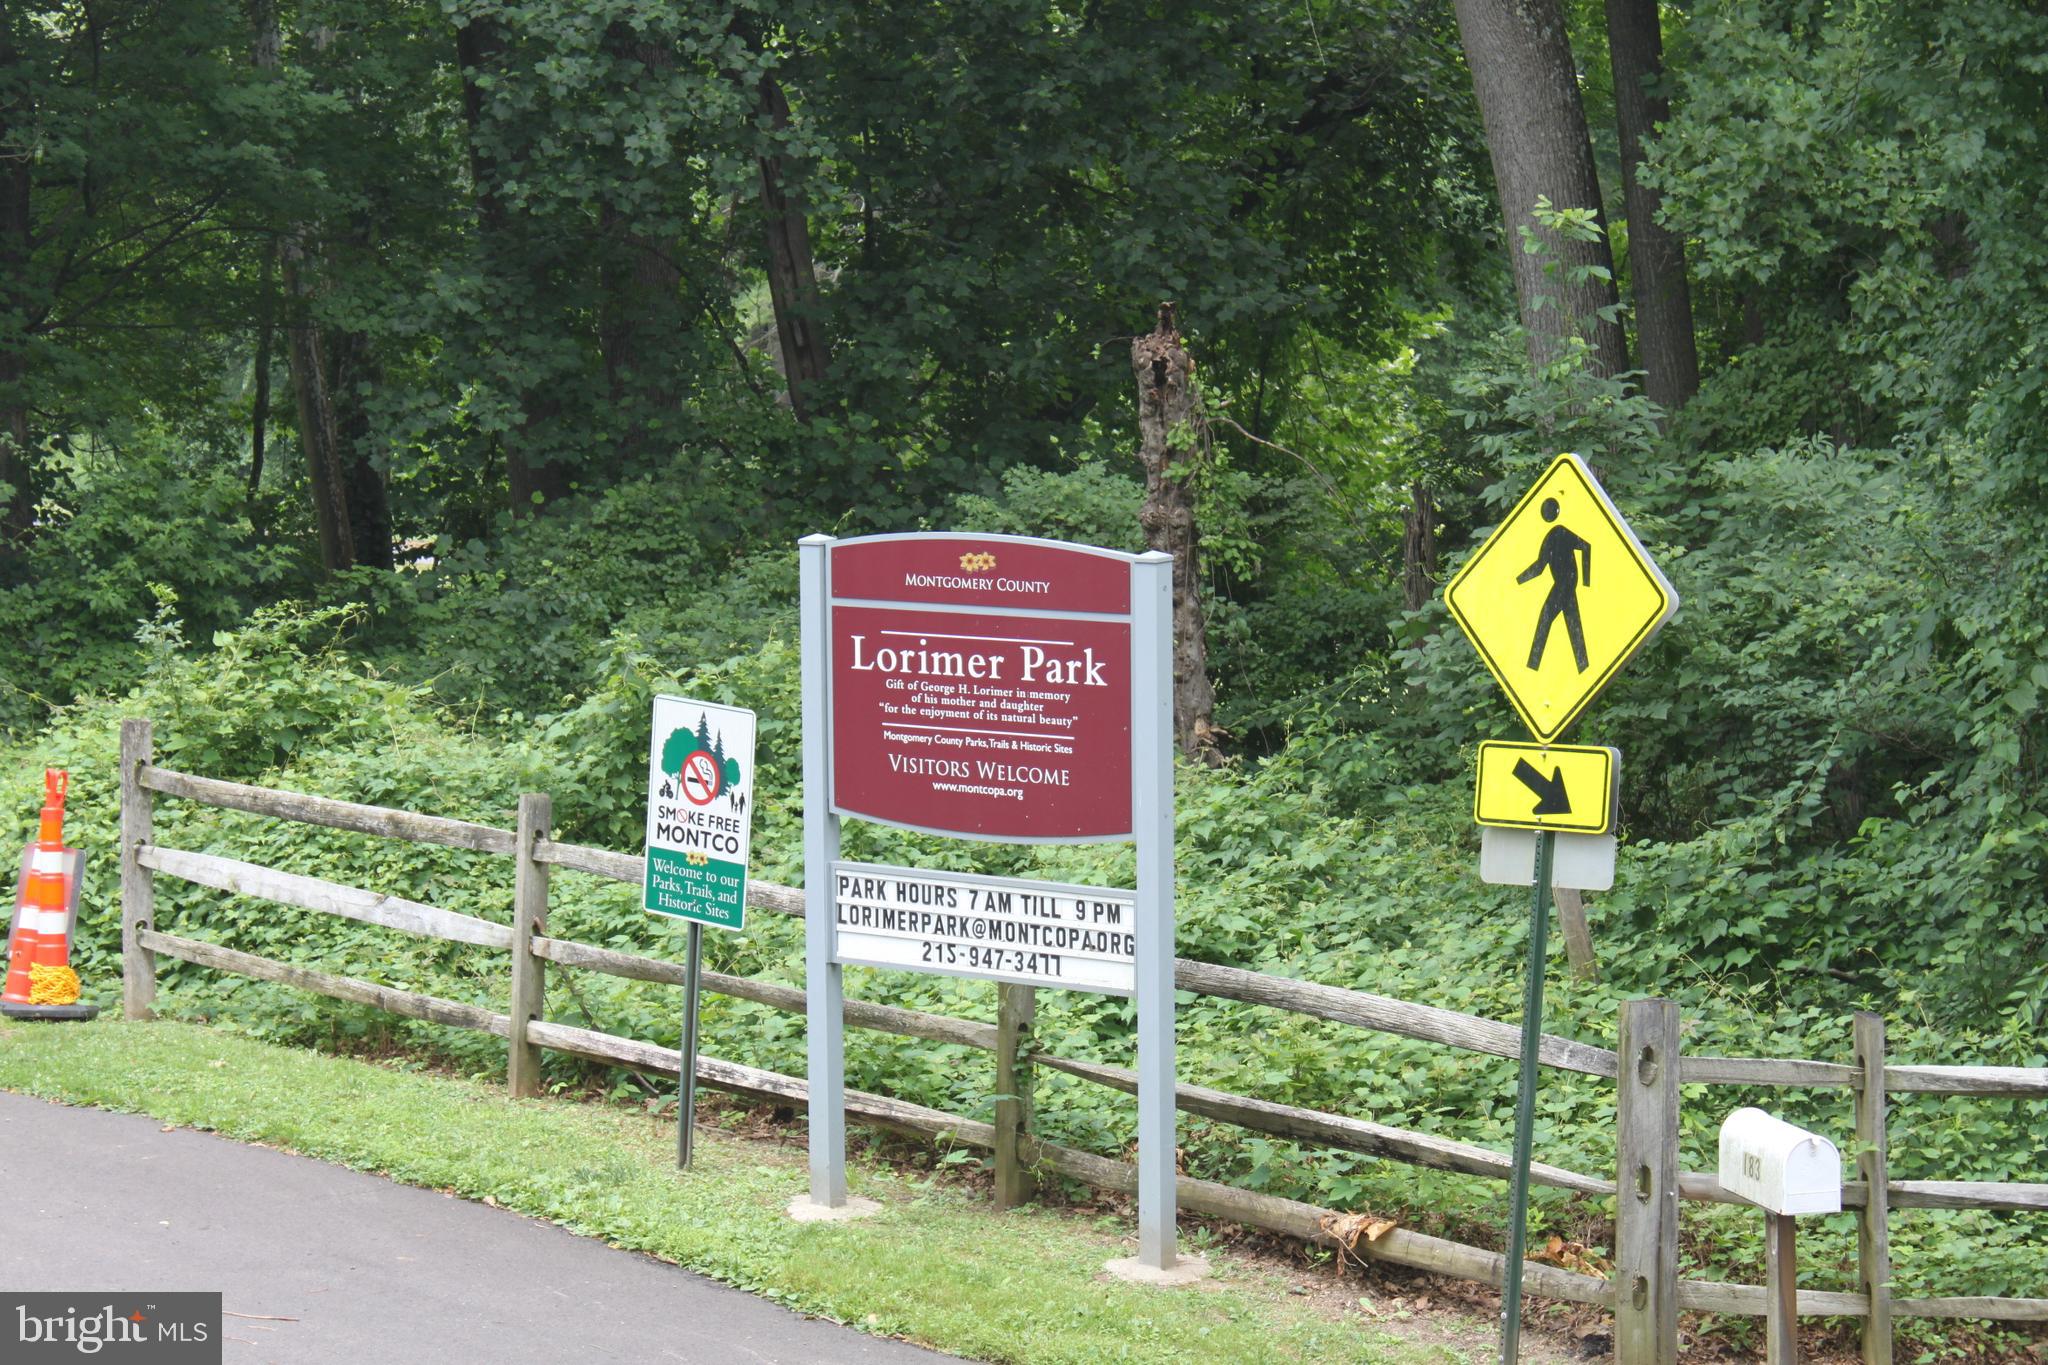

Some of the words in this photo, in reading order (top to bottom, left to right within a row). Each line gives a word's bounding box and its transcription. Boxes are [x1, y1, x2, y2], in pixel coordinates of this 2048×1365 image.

[905, 573, 993, 591] MONTGOMERY
[997, 578, 1050, 594] COUNTY
[851, 635, 1004, 679] Lorimer
[1020, 646, 1108, 686] Park
[886, 679, 904, 690] Gift
[908, 680, 918, 691] of
[920, 681, 955, 696] George
[958, 684, 971, 694] H.
[973, 684, 1013, 697] Lorimer
[1016, 688, 1027, 698] in
[1029, 690, 1070, 703] memory
[911, 693, 922, 703] of
[924, 693, 938, 704] his
[941, 695, 976, 708] mother
[979, 697, 997, 708] and
[1000, 698, 1044, 712] daughter
[901, 704, 917, 715] the
[919, 708, 971, 720] enjoyment
[973, 708, 984, 719] of
[986, 709, 998, 720] its
[1001, 711, 1036, 723] natural
[883, 730, 932, 746] Montgomery
[934, 733, 963, 748] County
[989, 738, 1010, 750] Trails
[1011, 740, 1018, 750] &
[1020, 740, 1052, 752] Historic
[1054, 743, 1073, 754] Sites
[888, 753, 969, 778] VISITORS
[976, 760, 1069, 786] WELCOME
[932, 781, 1023, 800] www.montcopa.org
[708, 815, 740, 833] FREE
[657, 823, 739, 854] MONTCO
[653, 858, 703, 879] Welcome
[706, 871, 717, 882] to
[720, 875, 739, 887] our
[653, 875, 683, 895] Parks,
[685, 881, 715, 901] Trails,
[718, 889, 737, 904] and
[839, 876, 886, 900] PARK
[897, 882, 957, 908] HOURS
[1021, 894, 1061, 918] TILL
[658, 892, 702, 913] Historic
[705, 902, 729, 919] Sites
[838, 904, 1135, 956] LORIMERPARK@MONTCOPA.ORG
[1744, 1153, 1760, 1180] 183
